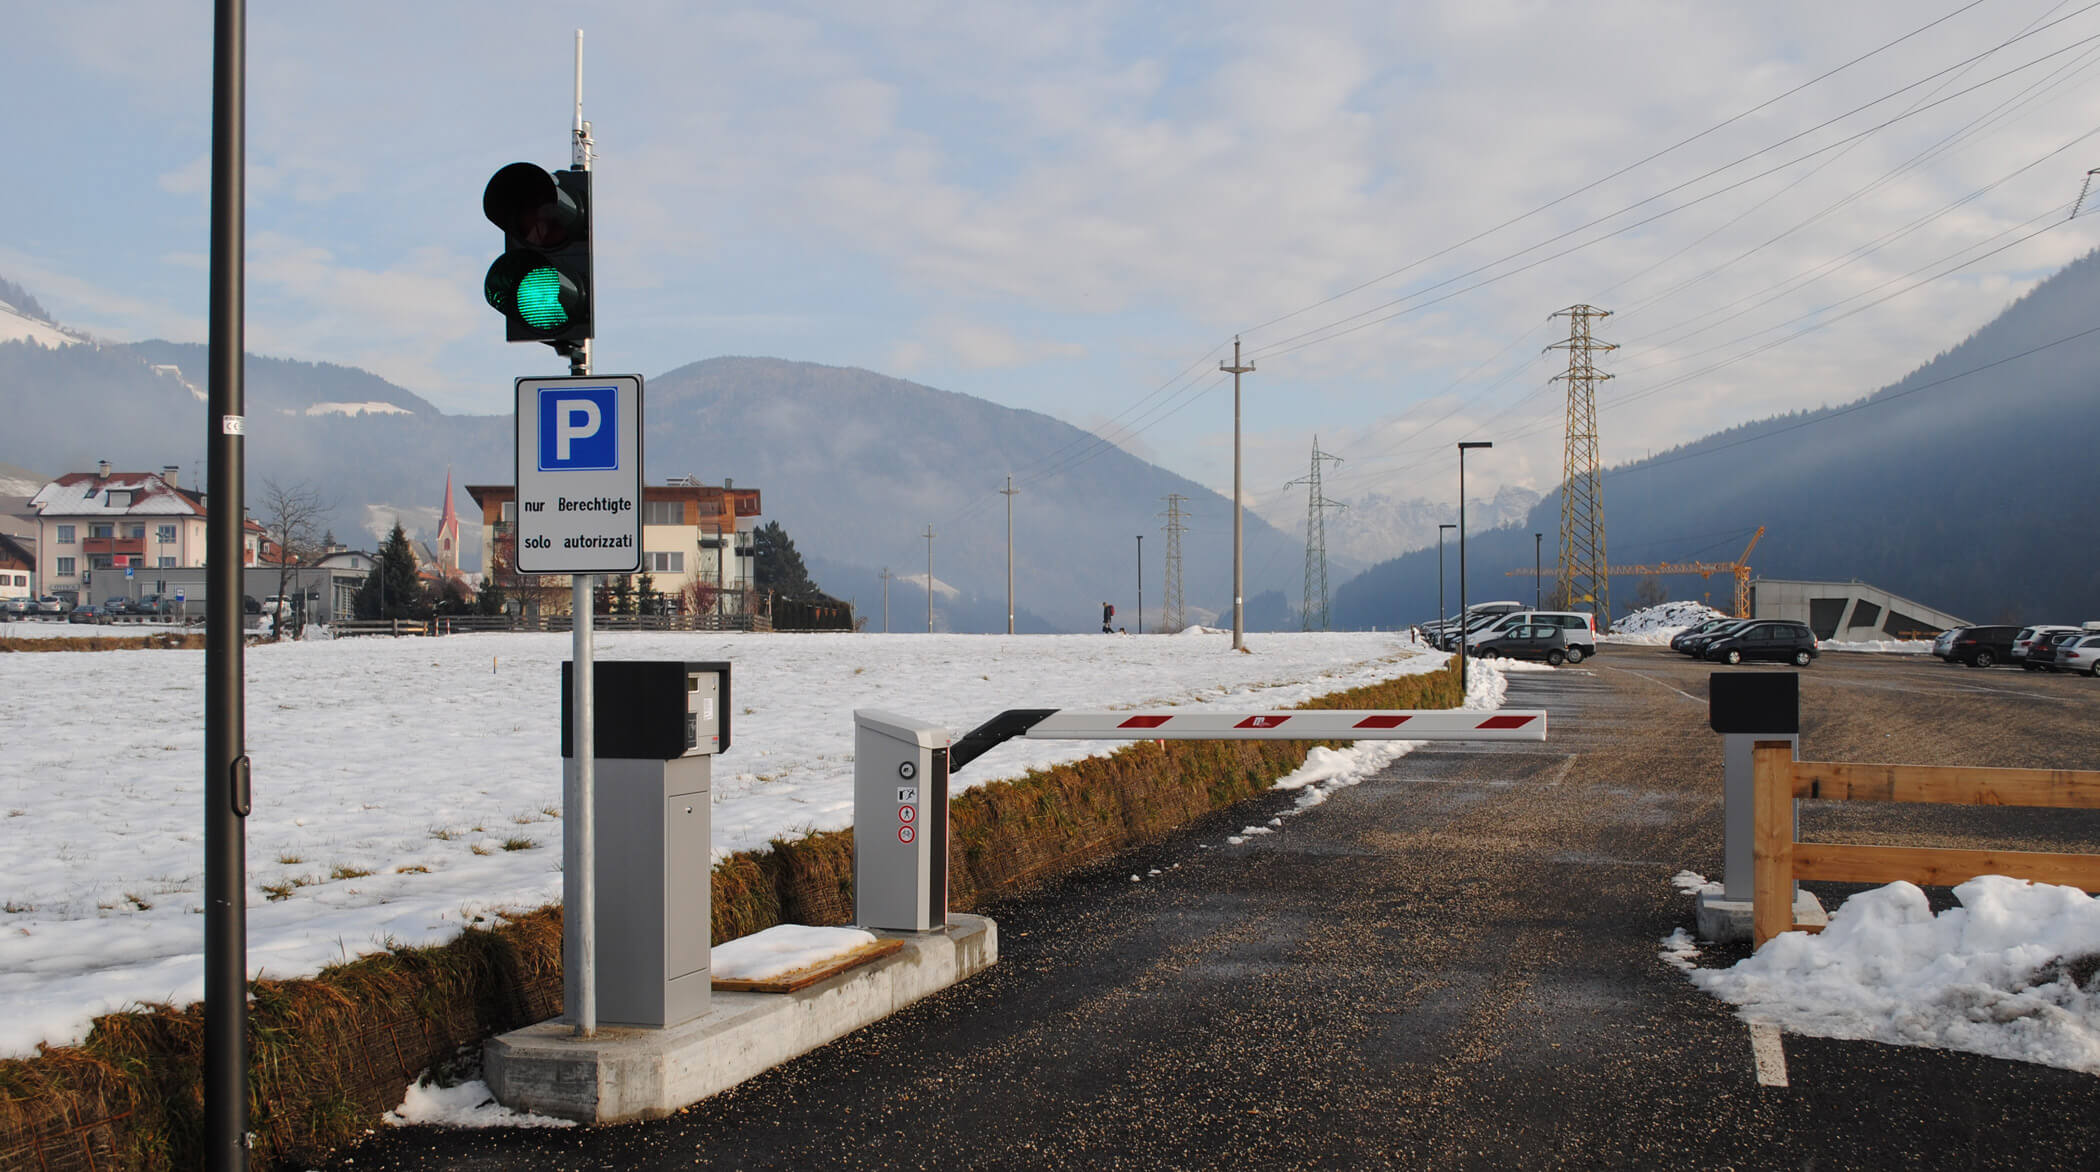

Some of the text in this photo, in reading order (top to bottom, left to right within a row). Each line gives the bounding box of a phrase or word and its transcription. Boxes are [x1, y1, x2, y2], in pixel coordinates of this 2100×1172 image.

[556, 399, 602, 460] P
[524, 497, 632, 514] nur Berechtigte
[524, 534, 633, 549] solo autorizzati
